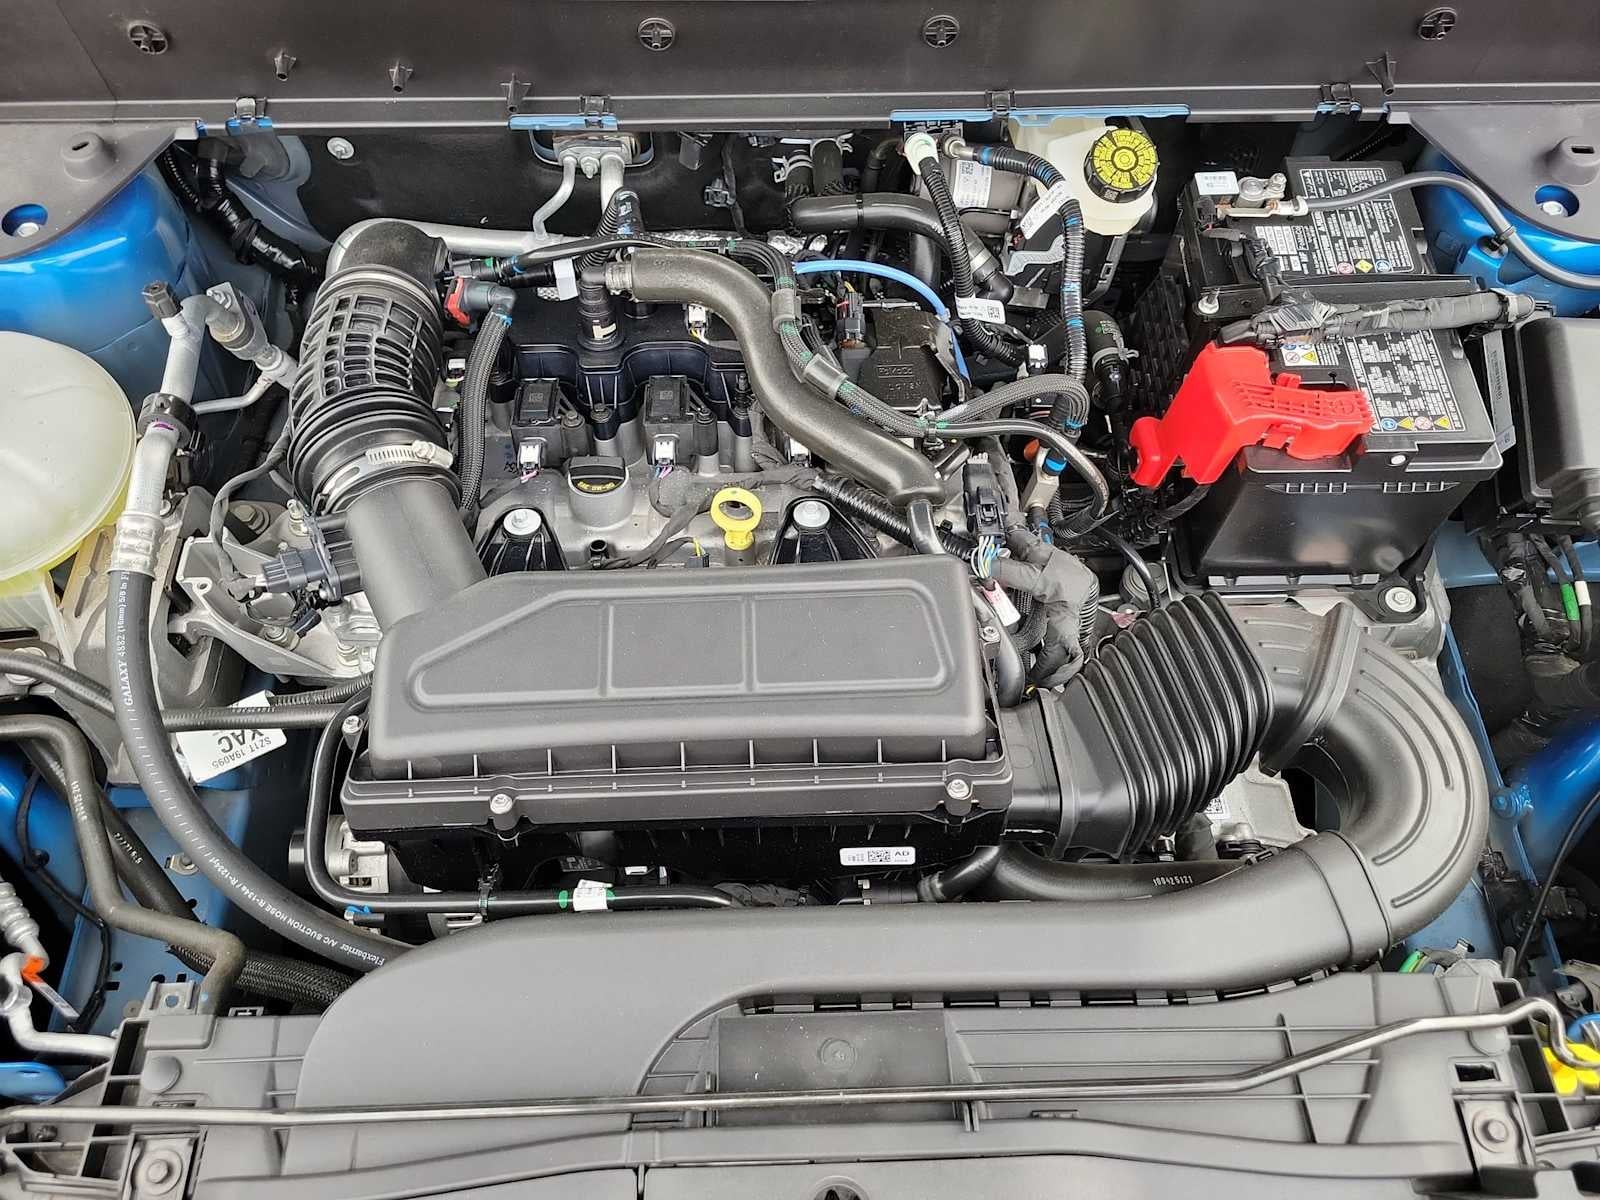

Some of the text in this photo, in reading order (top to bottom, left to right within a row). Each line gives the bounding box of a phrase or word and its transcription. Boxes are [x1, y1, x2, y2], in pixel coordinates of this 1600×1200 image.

[119, 660, 134, 706] GALAXY
[264, 905, 288, 922] HOSE
[286, 918, 324, 942] SUCTION
[323, 937, 338, 948] A/C
[340, 943, 385, 966] Flexbarrier
